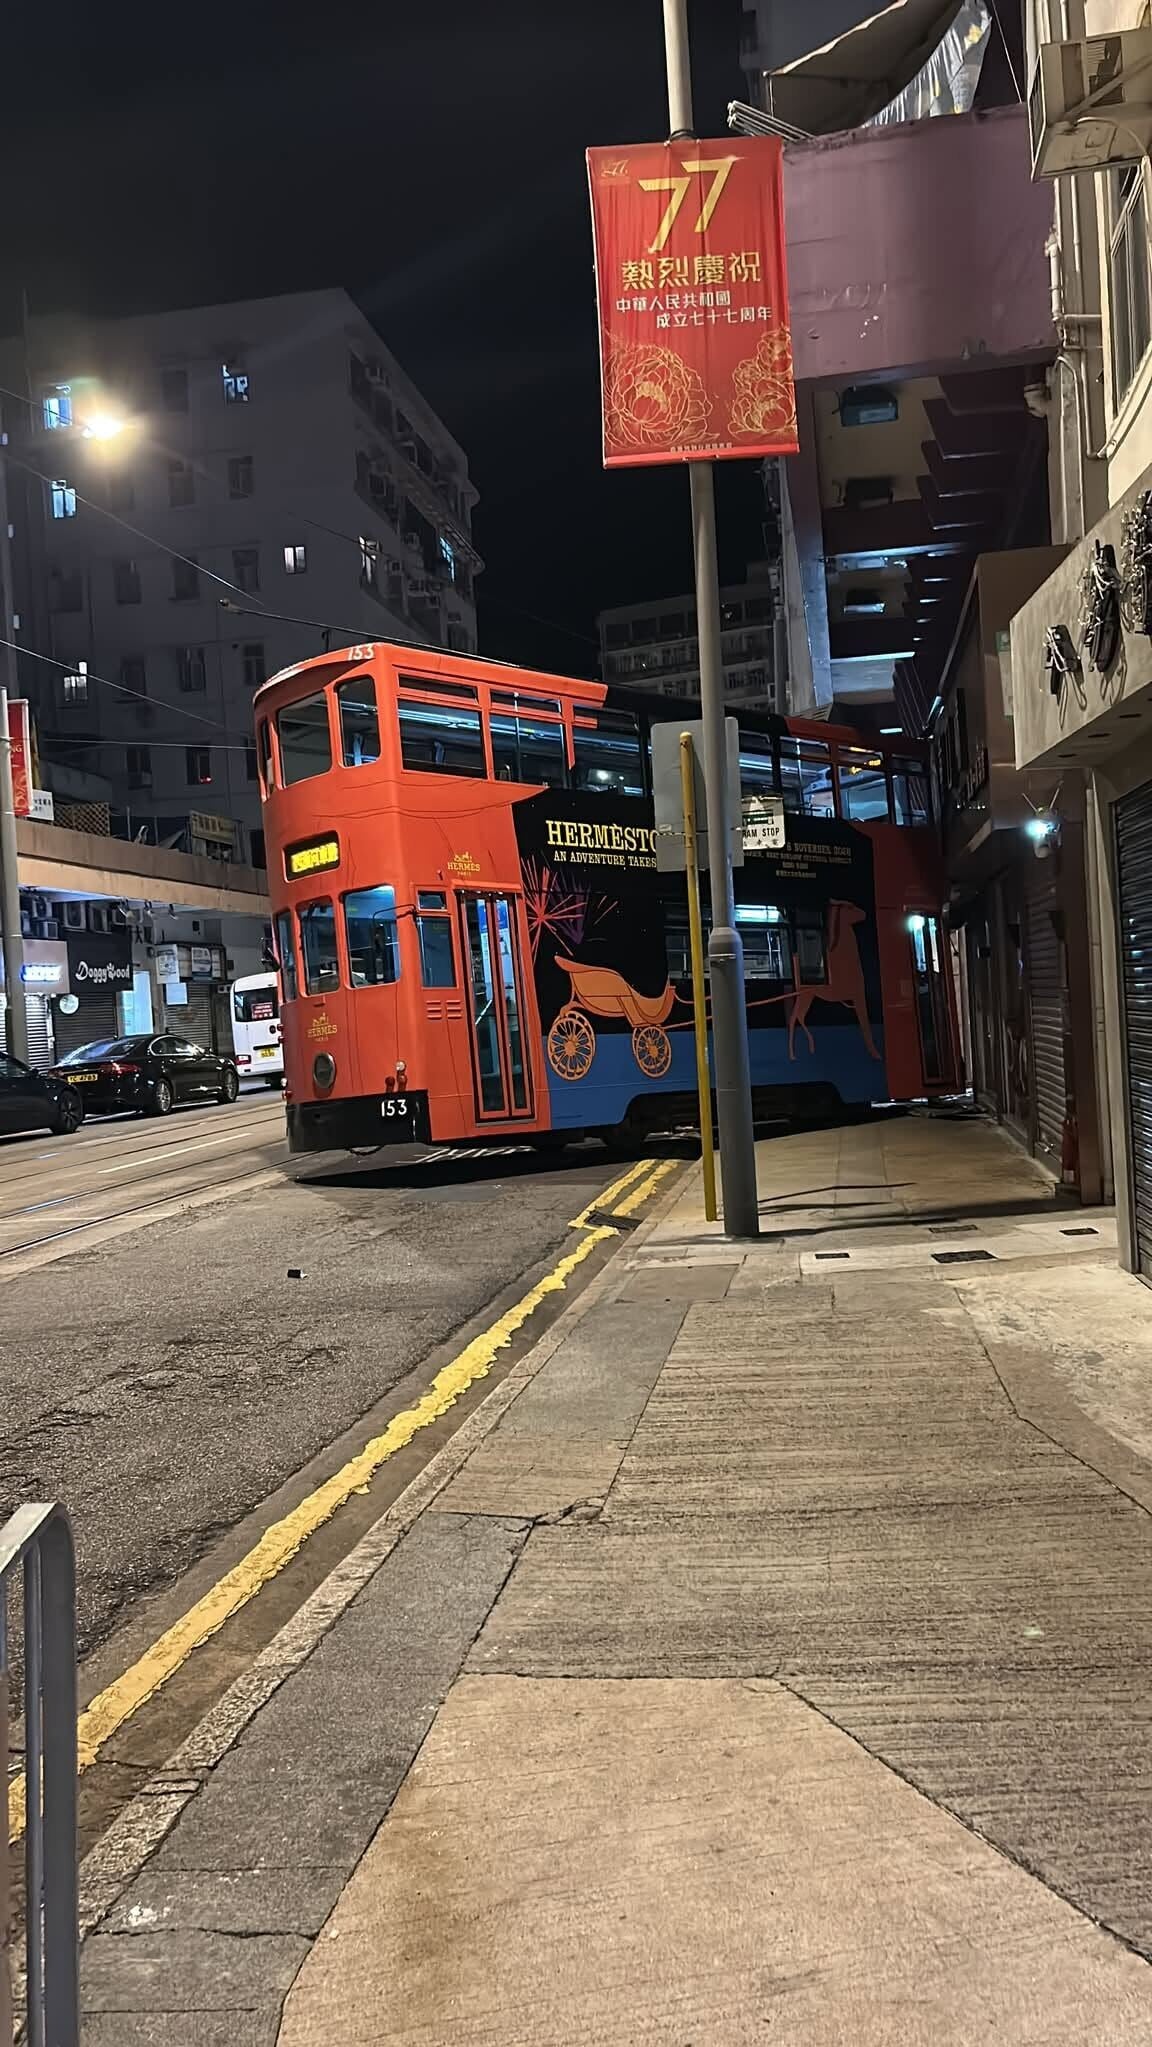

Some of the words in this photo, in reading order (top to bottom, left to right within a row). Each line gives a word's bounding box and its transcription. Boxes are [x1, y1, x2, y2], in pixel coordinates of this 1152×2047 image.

[638, 155, 738, 254] 77
[621, 252, 761, 292] 熱烈慶祝
[616, 290, 731, 313] 中華人民共和國
[656, 306, 772, 329] 成立七十七周年
[347, 644, 375, 661] 153
[743, 829, 758, 838] RAM
[762, 828, 780, 837] STOP
[553, 850, 567, 862] AN
[570, 851, 626, 866] ADVENTURE
[628, 855, 657, 868] TAKES
[381, 1099, 407, 1117] 153
